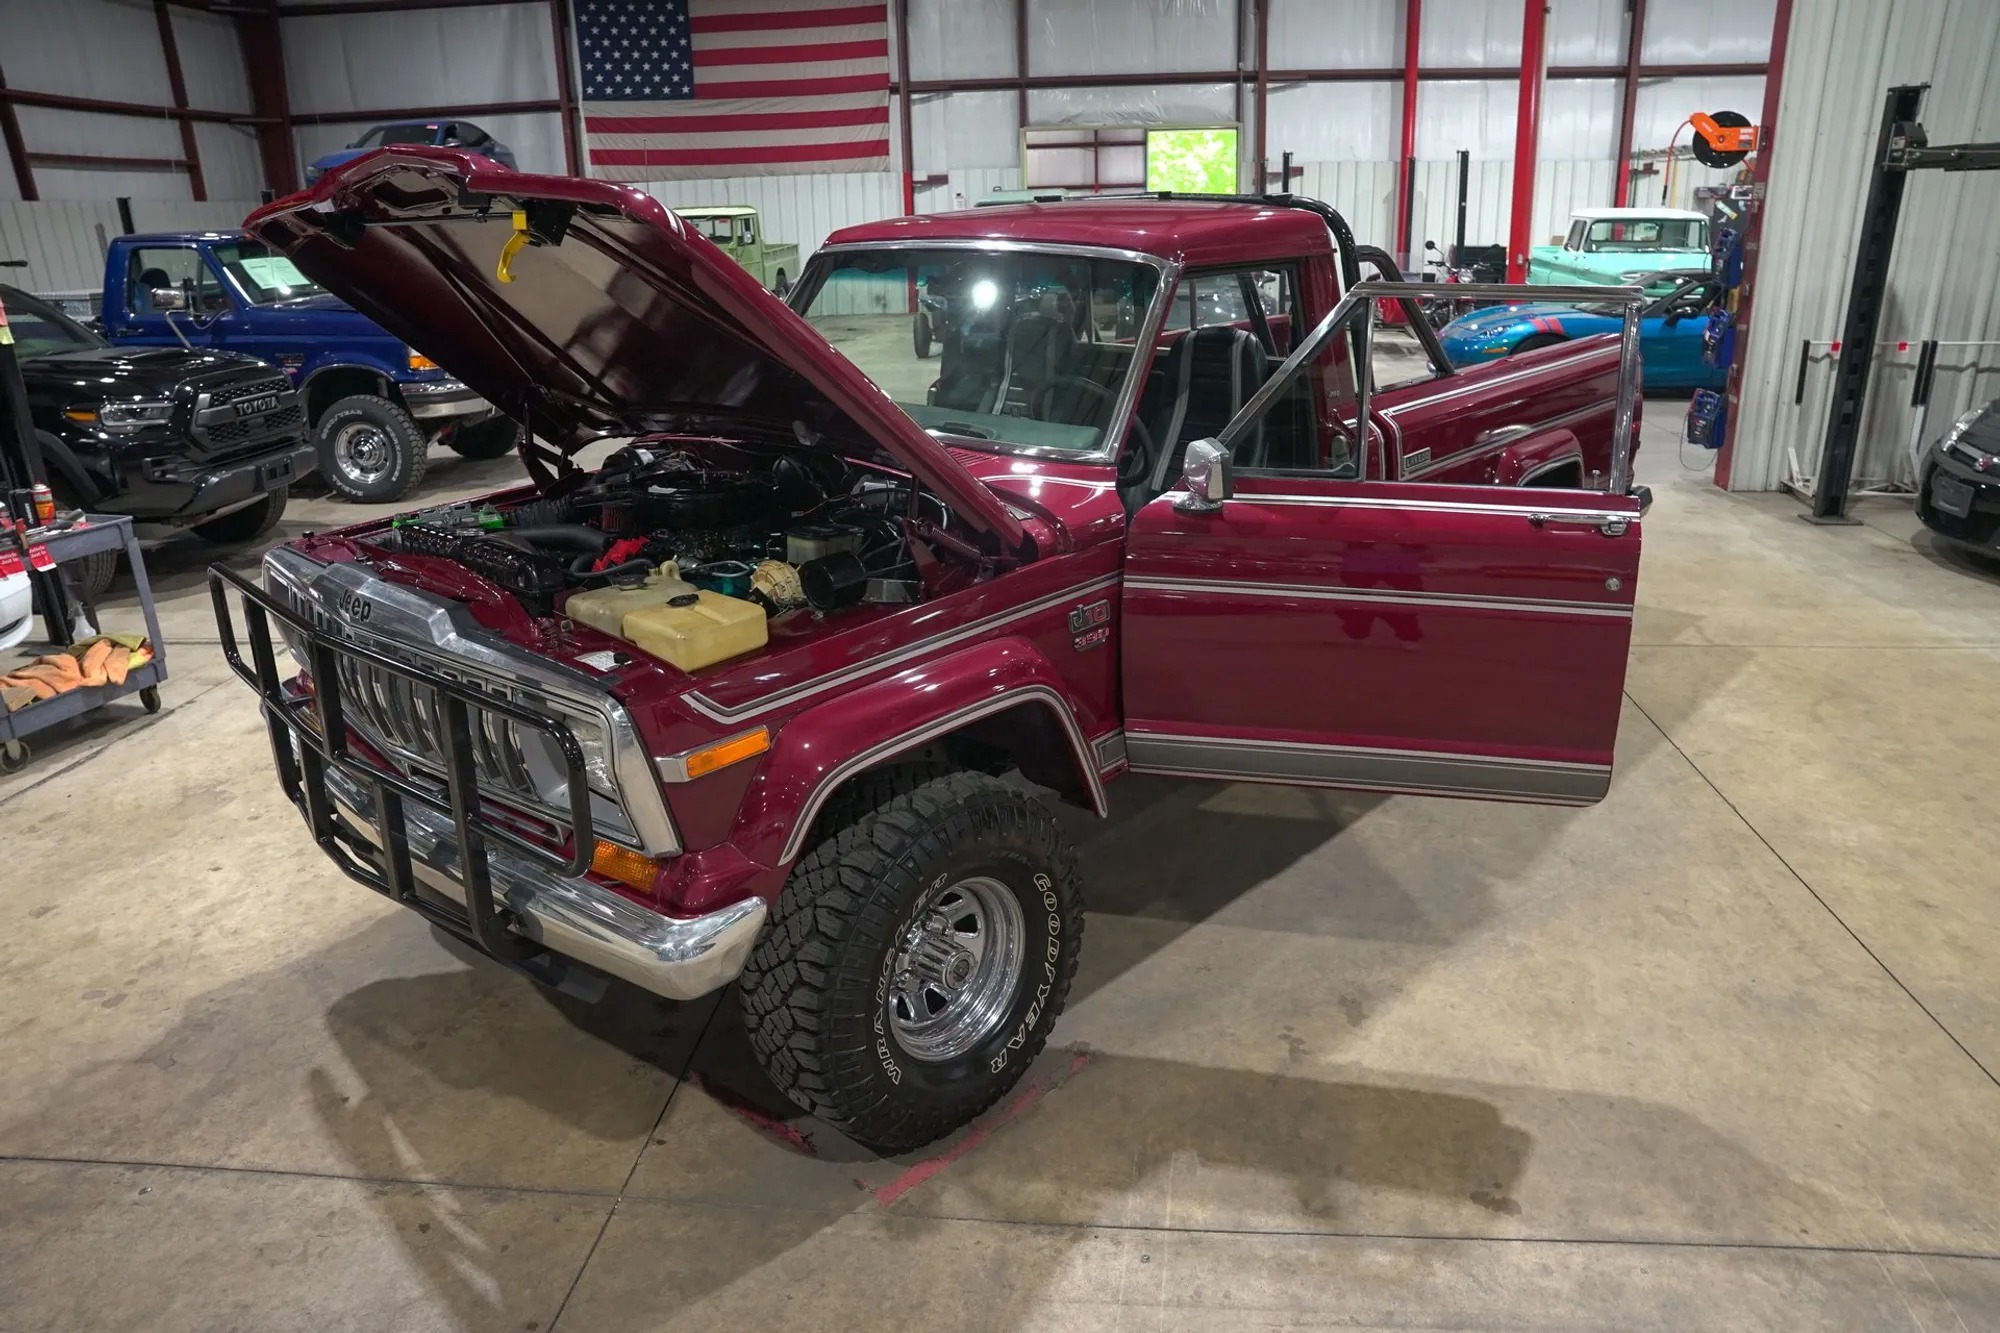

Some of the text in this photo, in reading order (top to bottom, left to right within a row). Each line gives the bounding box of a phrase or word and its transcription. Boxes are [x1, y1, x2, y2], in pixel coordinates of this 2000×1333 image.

[237, 396, 281, 416] TOYOTA
[340, 589, 371, 621] Jeep
[1073, 604, 1107, 627] J10
[874, 873, 947, 1085] WRANGLER
[991, 873, 1060, 1073] GOODYEAR
